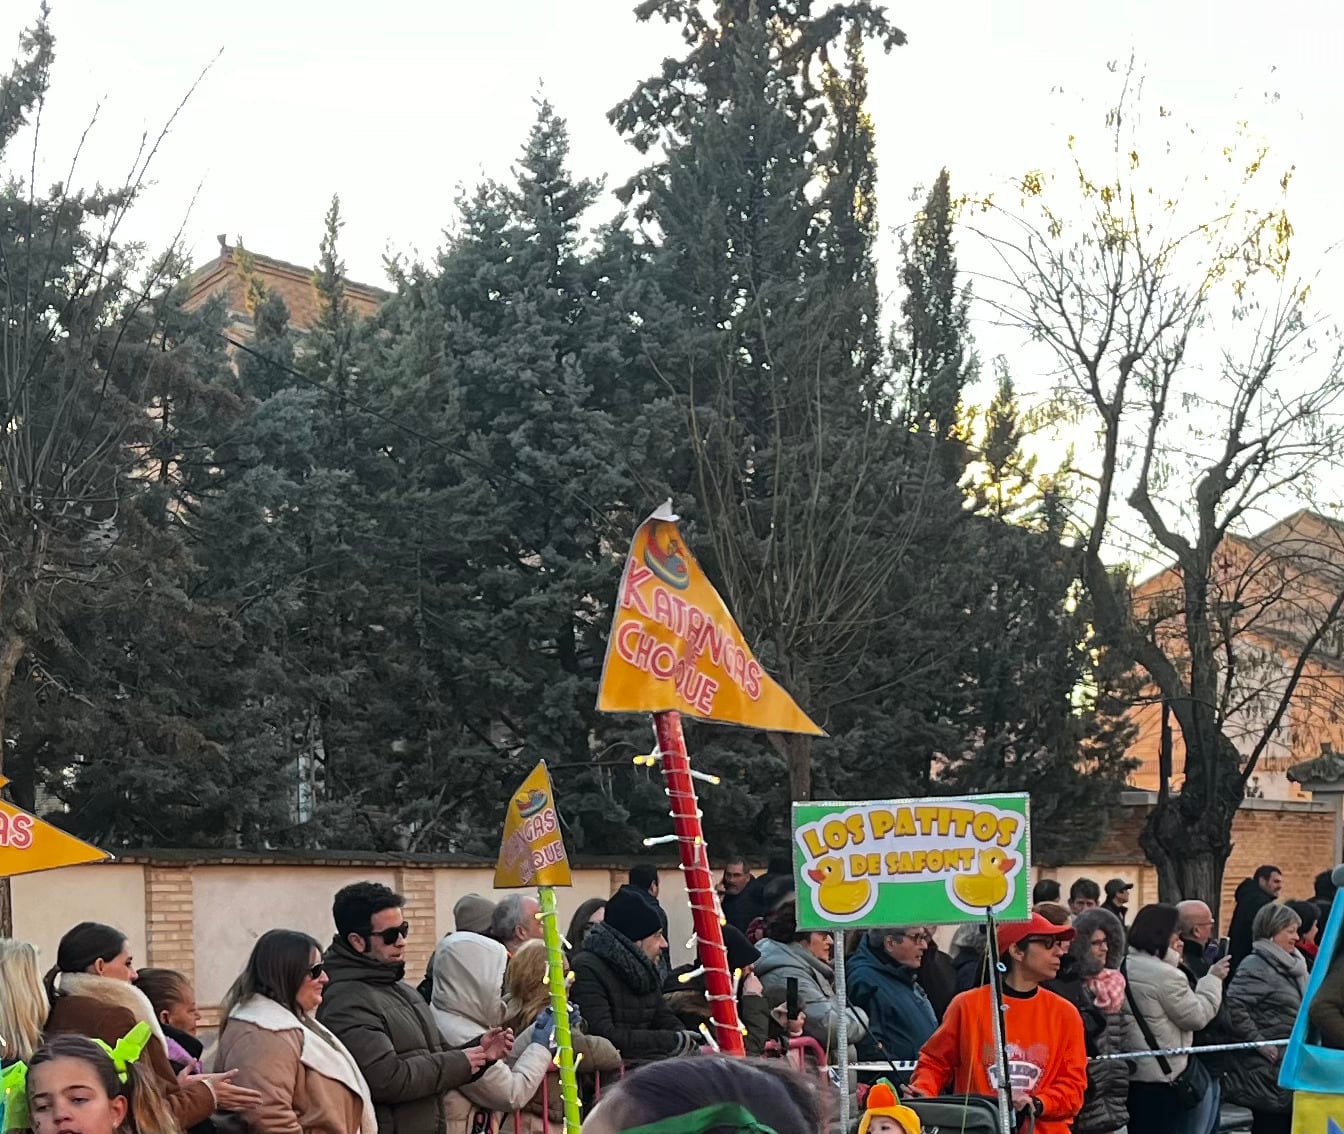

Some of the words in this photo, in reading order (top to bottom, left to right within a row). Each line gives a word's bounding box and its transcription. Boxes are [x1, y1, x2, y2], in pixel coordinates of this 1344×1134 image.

[622, 557, 762, 700] KATANGAS
[617, 620, 718, 715] CHOQUE
[802, 813, 866, 858] LOS
[869, 806, 1019, 847] PATITOS
[850, 853, 881, 876] DE
[885, 848, 975, 875] SAFONT
